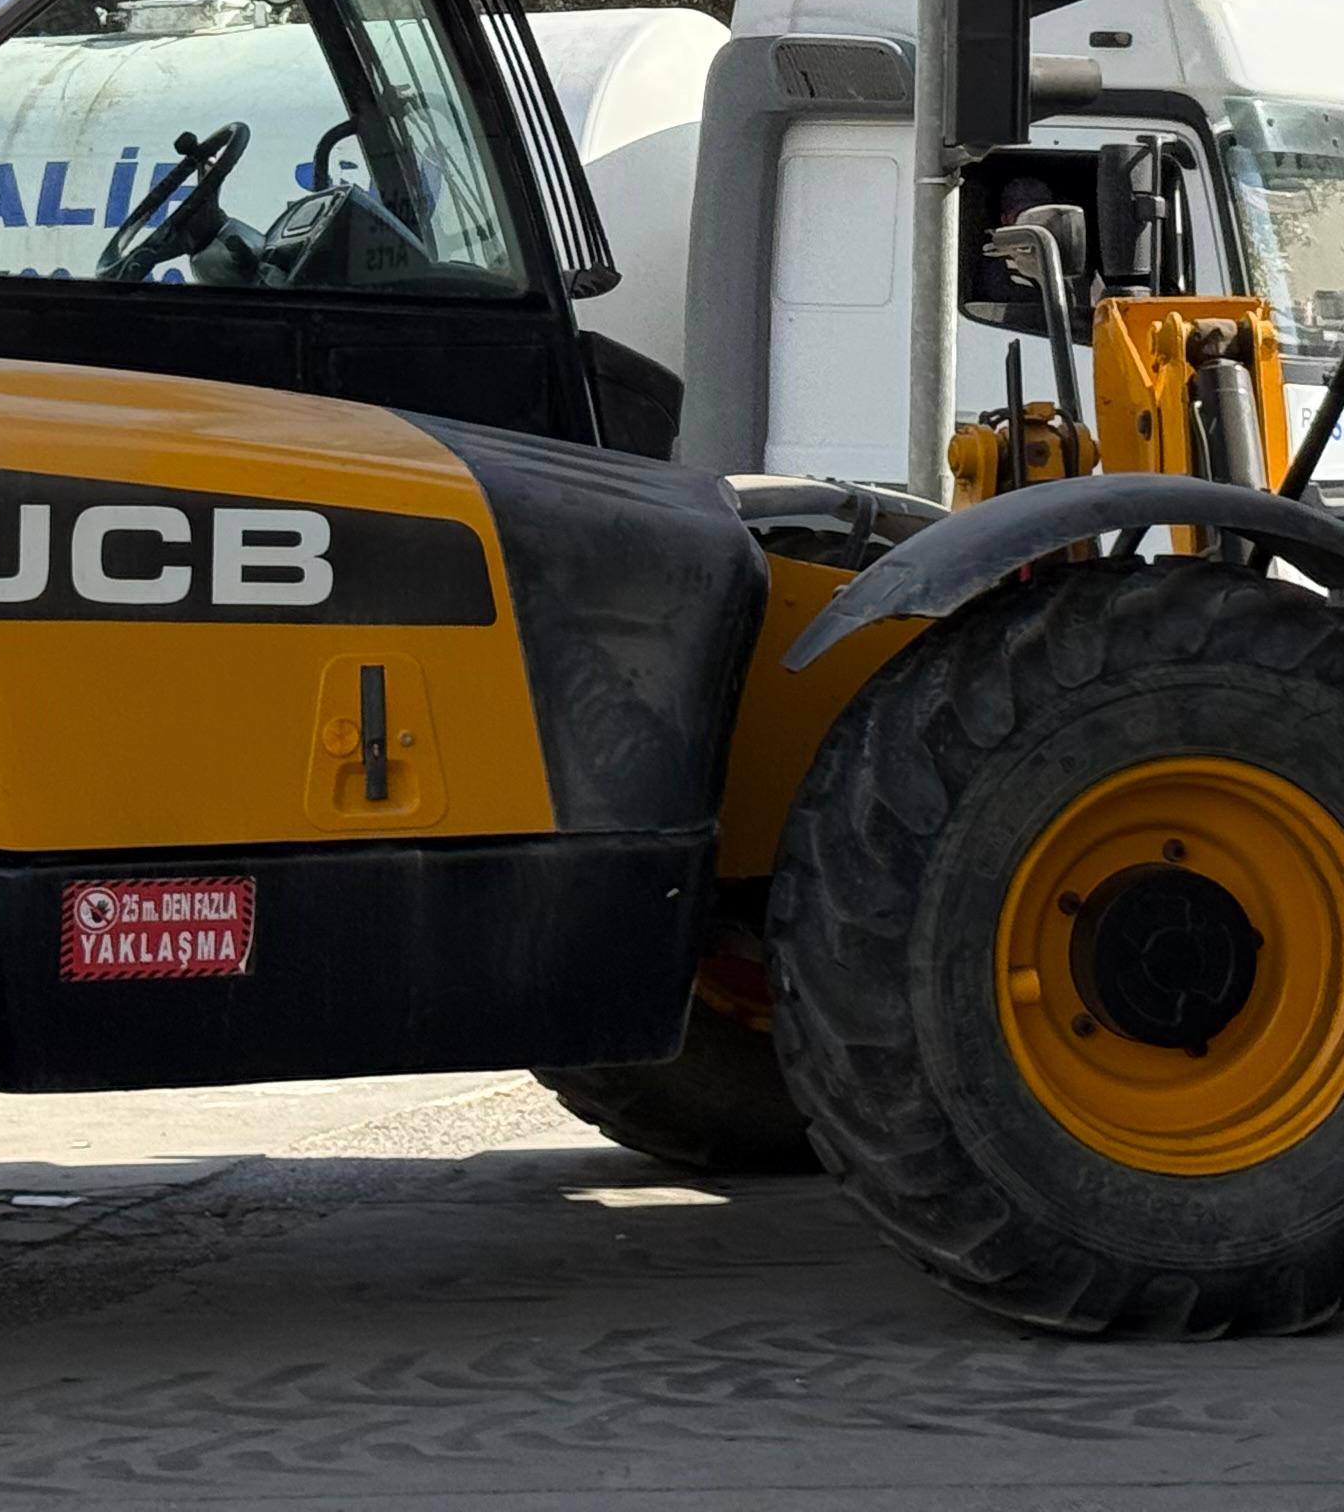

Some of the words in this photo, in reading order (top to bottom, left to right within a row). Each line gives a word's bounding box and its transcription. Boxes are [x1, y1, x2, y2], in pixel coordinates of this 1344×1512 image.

[122, 894, 140, 922] 25
[162, 893, 192, 921] DEN
[193, 891, 237, 920] FAZLA
[80, 930, 236, 969] YAKLAŞMA
